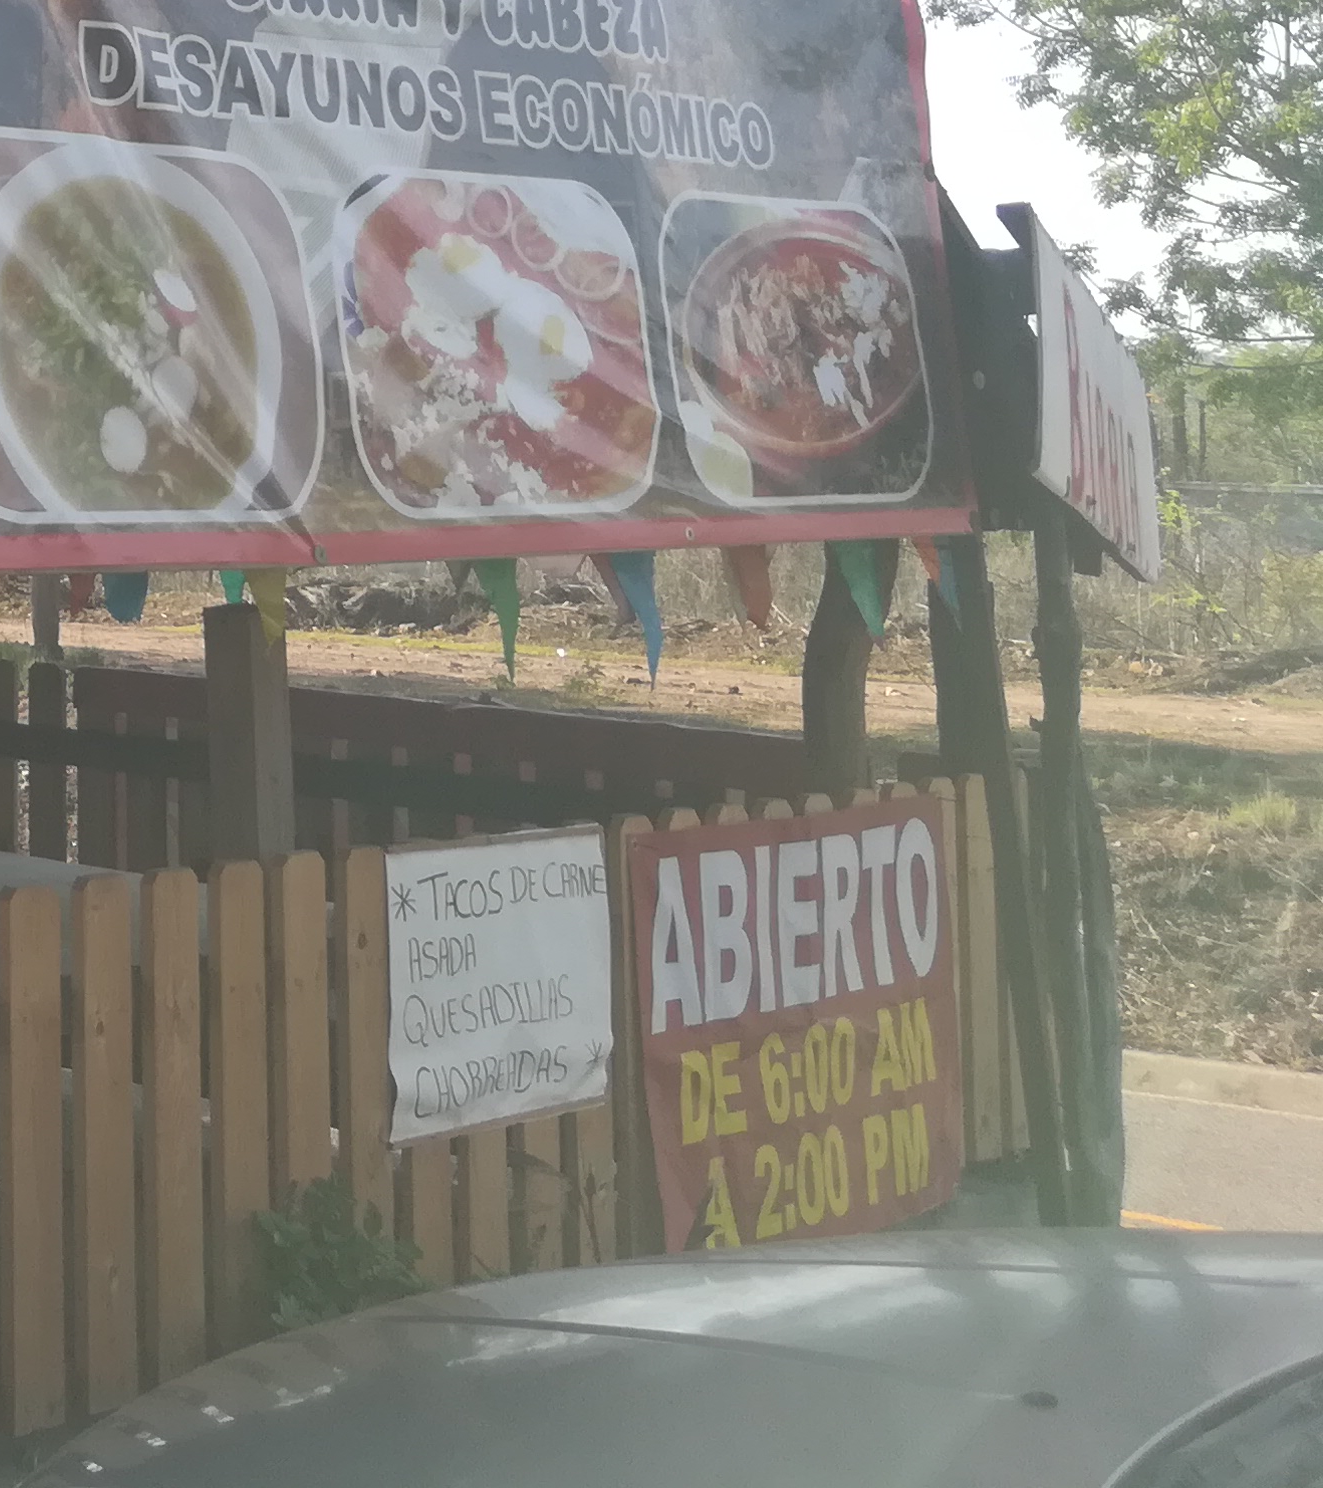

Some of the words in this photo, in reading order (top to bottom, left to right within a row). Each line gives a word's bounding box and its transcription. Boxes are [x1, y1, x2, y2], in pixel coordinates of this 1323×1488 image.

[78, 18, 468, 146] DESAYUNOS
[476, 70, 776, 170] ECONÓMICO
[510, 866, 539, 905] DE
[543, 861, 608, 900] CARNE
[651, 817, 939, 1036] ABIERTO
[402, 974, 574, 1047] QUESADILLAS
[407, 933, 477, 984] ASADA
[414, 1045, 568, 1119] CHORREADAS
[680, 1041, 748, 1147] DE
[759, 1016, 855, 1125] 6:00
[870, 996, 937, 1098] AM
[705, 1156, 743, 1250] A
[753, 1124, 849, 1241] 2:00
[863, 1102, 929, 1206] PM
